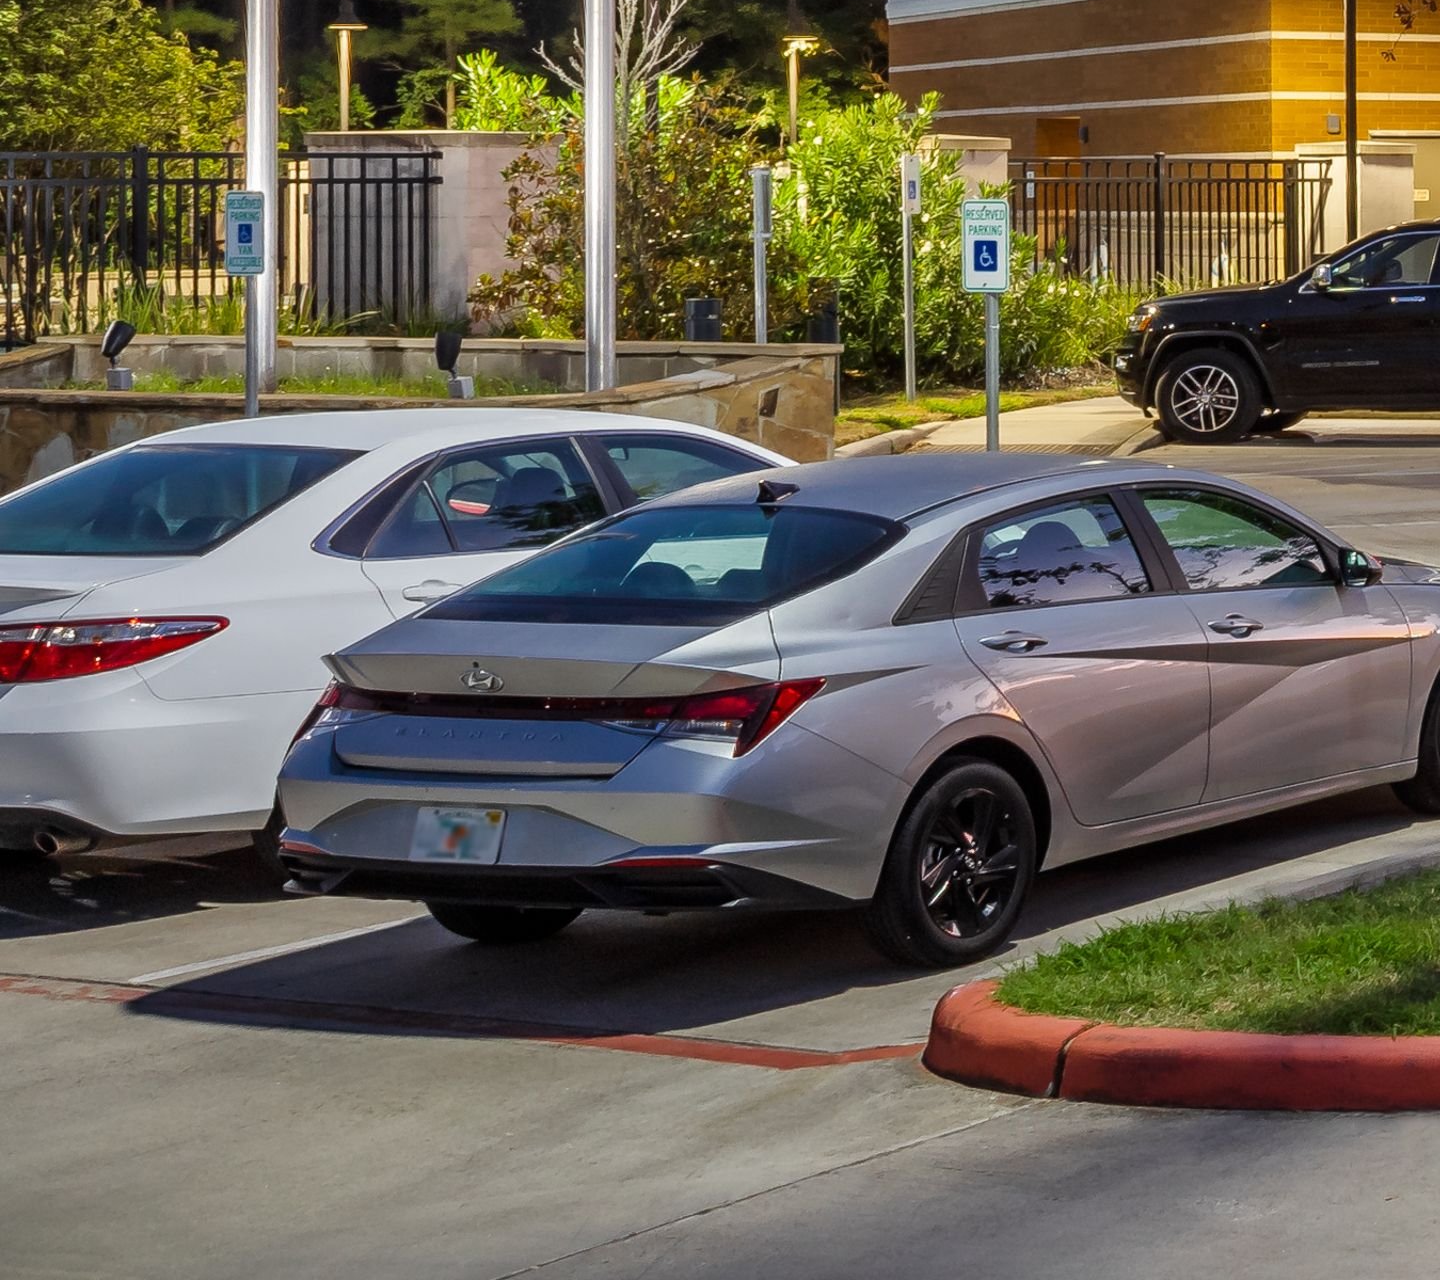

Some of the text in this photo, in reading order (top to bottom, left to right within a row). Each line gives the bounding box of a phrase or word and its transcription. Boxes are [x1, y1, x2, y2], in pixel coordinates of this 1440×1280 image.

[966, 209, 1005, 221] RESERVED
[968, 224, 1003, 236] PARKING
[394, 727, 564, 742] ELANTRA
